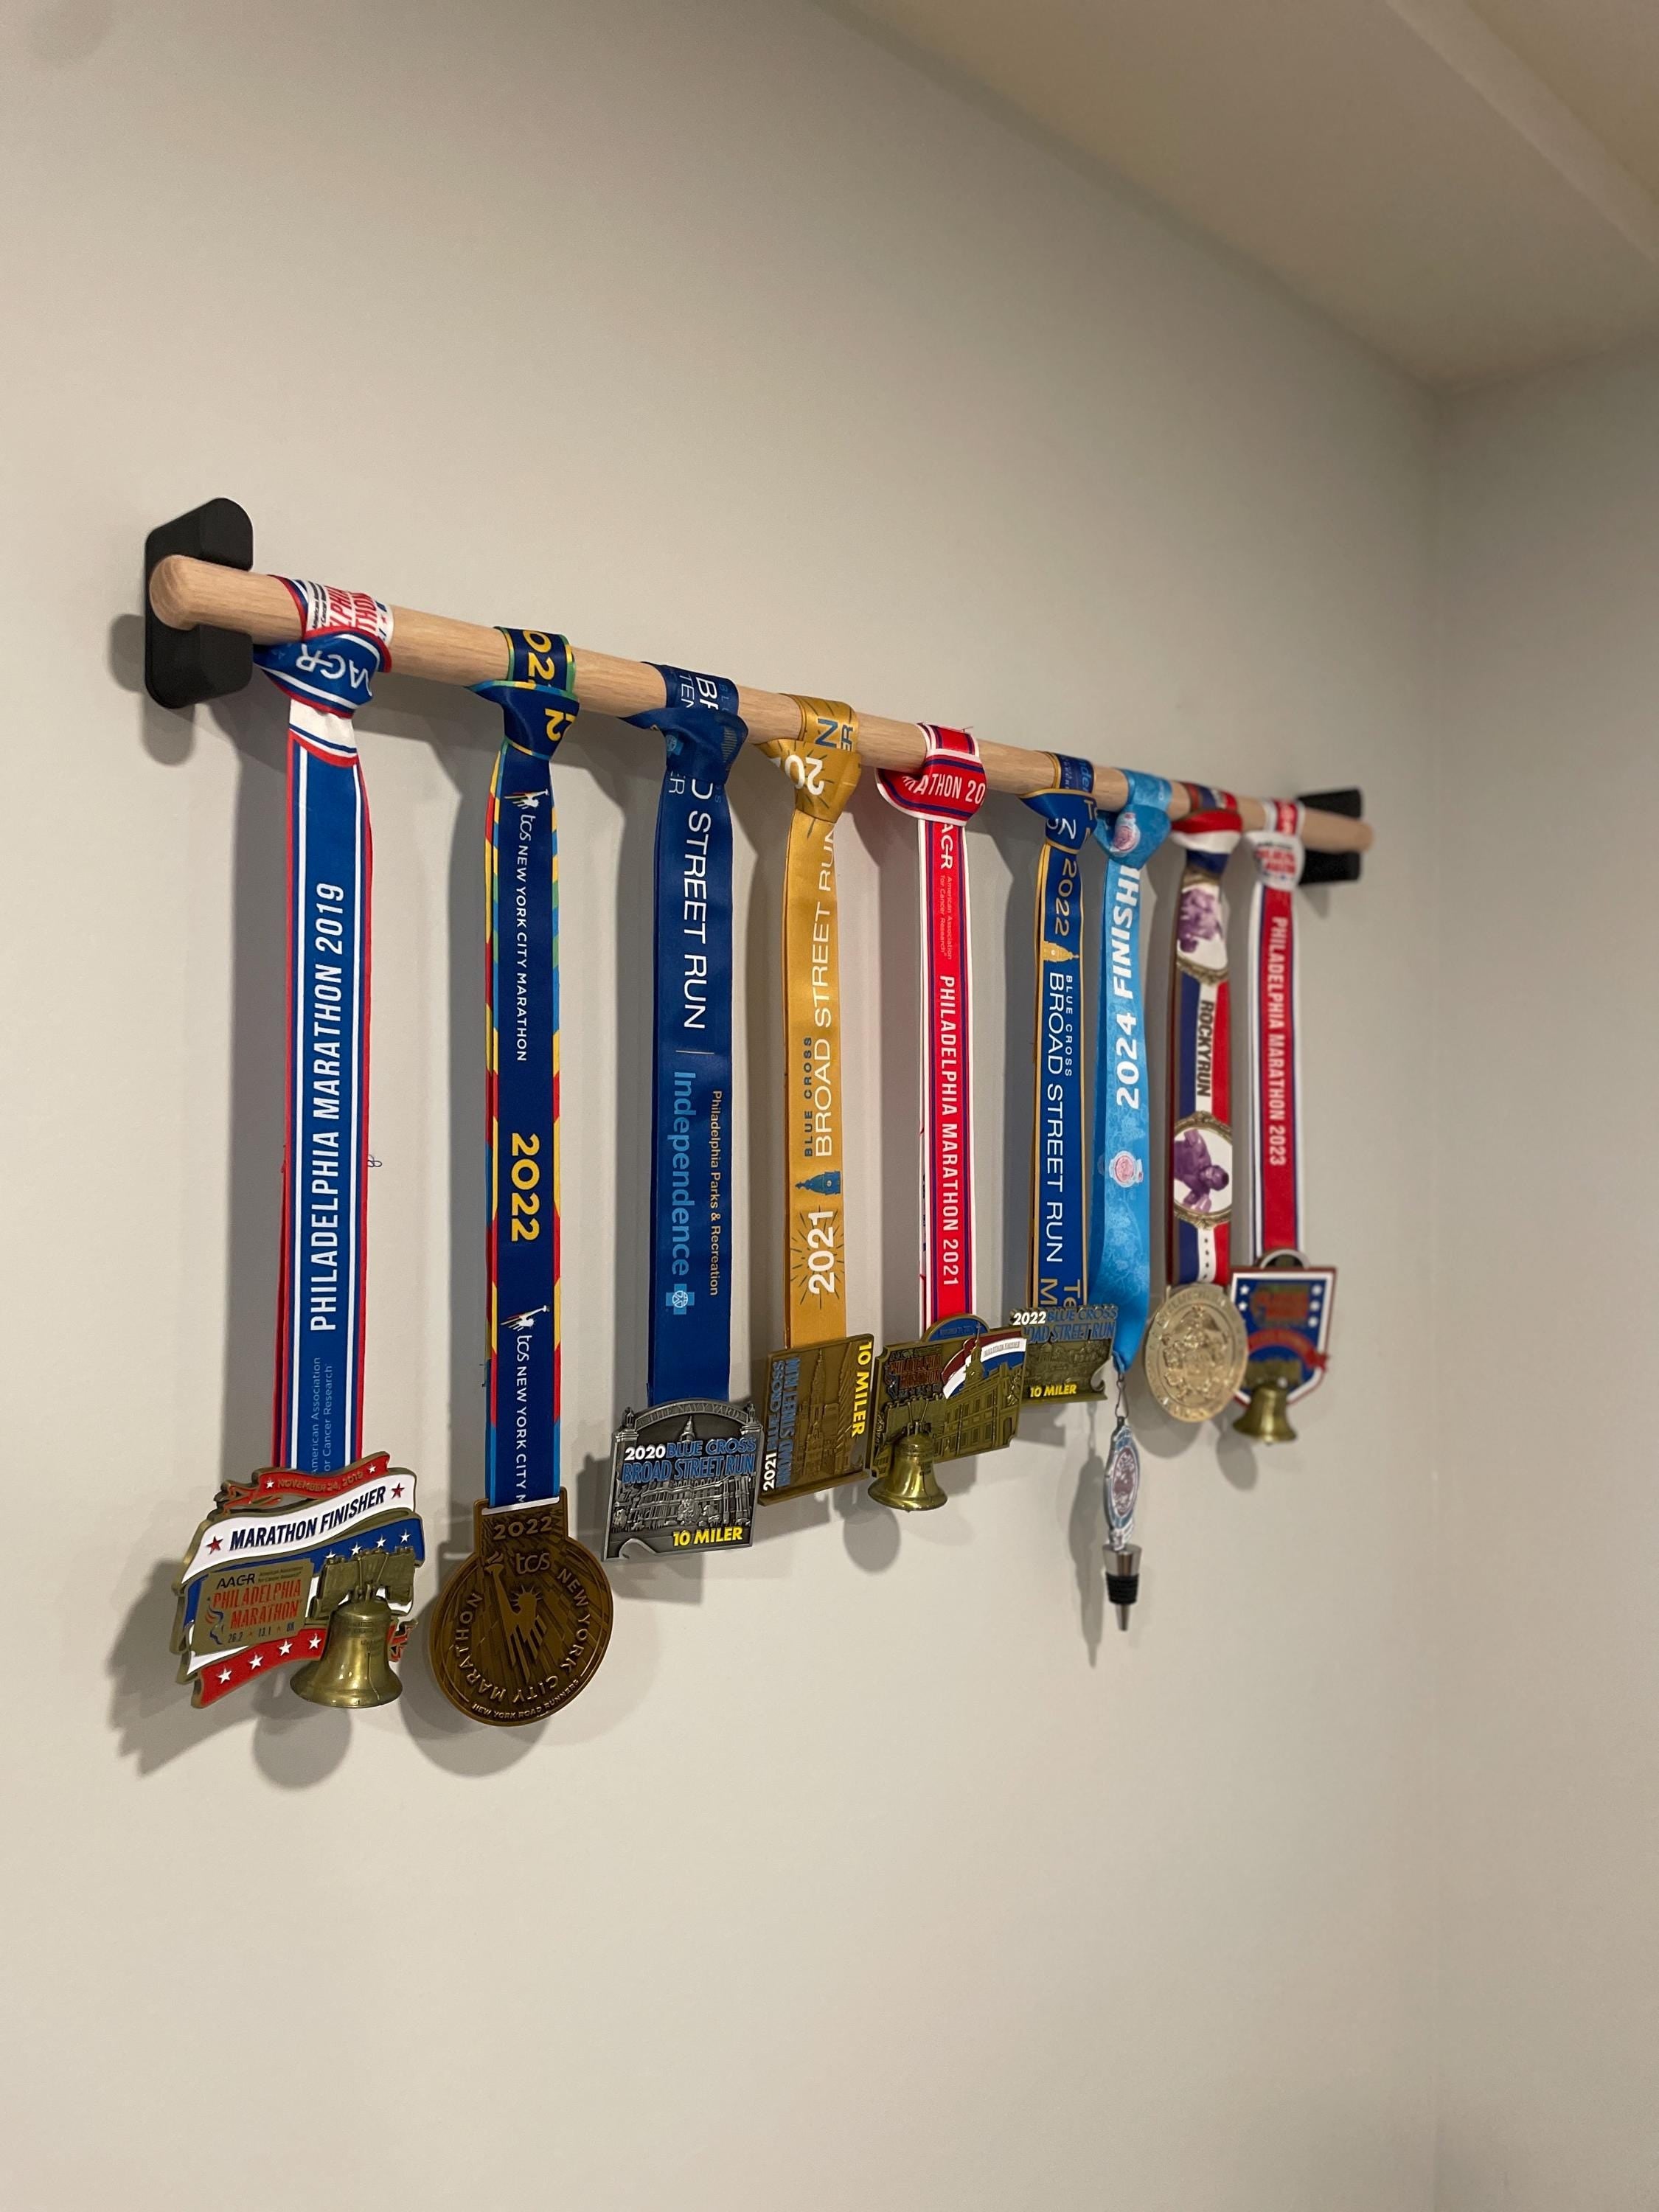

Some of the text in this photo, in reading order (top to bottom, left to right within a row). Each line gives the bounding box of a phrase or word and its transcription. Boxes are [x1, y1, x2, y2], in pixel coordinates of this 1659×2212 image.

[684, 810, 712, 944] STREET
[1054, 858, 1077, 936] 2022
[515, 813, 536, 1062] tcs NEW YORK CITY MARATHON
[812, 900, 832, 1029] STREET
[684, 954, 707, 1029] RUN
[1048, 972, 1065, 1075] BROAD
[1065, 975, 1074, 1077] BLUE CROSS
[1267, 917, 1288, 1166] PHILADELPHIA MARATHON 2023
[1116, 1012, 1140, 1110] 2024
[310, 883, 345, 1331] PHILADELPHIA MARATHON 2019
[803, 1037, 813, 1158] BLUE CROSS
[814, 1038, 832, 1157] BROAD
[939, 975, 959, 1285] PHILADELPHIA MARATHON 2021
[1047, 1082, 1063, 1192] STREET
[511, 1133, 540, 1242] 2022
[667, 1071, 697, 1276] Independence
[709, 1090, 723, 1297] Philadelphia Parks & Recreation
[807, 1211, 835, 1294] 2021
[1046, 1201, 1063, 1262] RUN
[1012, 1305, 1118, 1326] 2022 BLUE CROSS
[1063, 1279, 1081, 1308] Te
[516, 1334, 532, 1362] tcs
[1050, 1324, 1092, 1342] STREET
[1091, 1321, 1116, 1339] RUN
[310, 1357, 321, 1420] Association
[516, 1366, 527, 1402] NEW
[677, 1402, 709, 1412] NAVY
[711, 1403, 740, 1419] YARD
[851, 1340, 873, 1438] 10 MILER
[1030, 1383, 1077, 1398] 10 MILER
[323, 1365, 333, 1472] or Cancer Research
[516, 1406, 527, 1448] YORK
[625, 1437, 757, 1461] 2020 BLUE CROSS
[277, 1478, 326, 1492] NOVEMBER
[341, 1471, 364, 1487] 2019
[515, 1454, 526, 1489] CITY
[622, 1453, 755, 1485] BROAD STREET RUN
[763, 1452, 777, 1492] 2021
[229, 1486, 386, 1551] MARATHON FINISHER
[493, 1515, 553, 1541] 2022
[673, 1526, 743, 1547] 10 MILER
[212, 1579, 302, 1610] PHILADELPHIA
[515, 1551, 551, 1575] tcs
[230, 1601, 299, 1630] MARATHON
[455, 1568, 591, 1704] NEW YORK CITY MARATHON
[471, 1679, 580, 1719] NEW YORK ROAD RUNNERS
